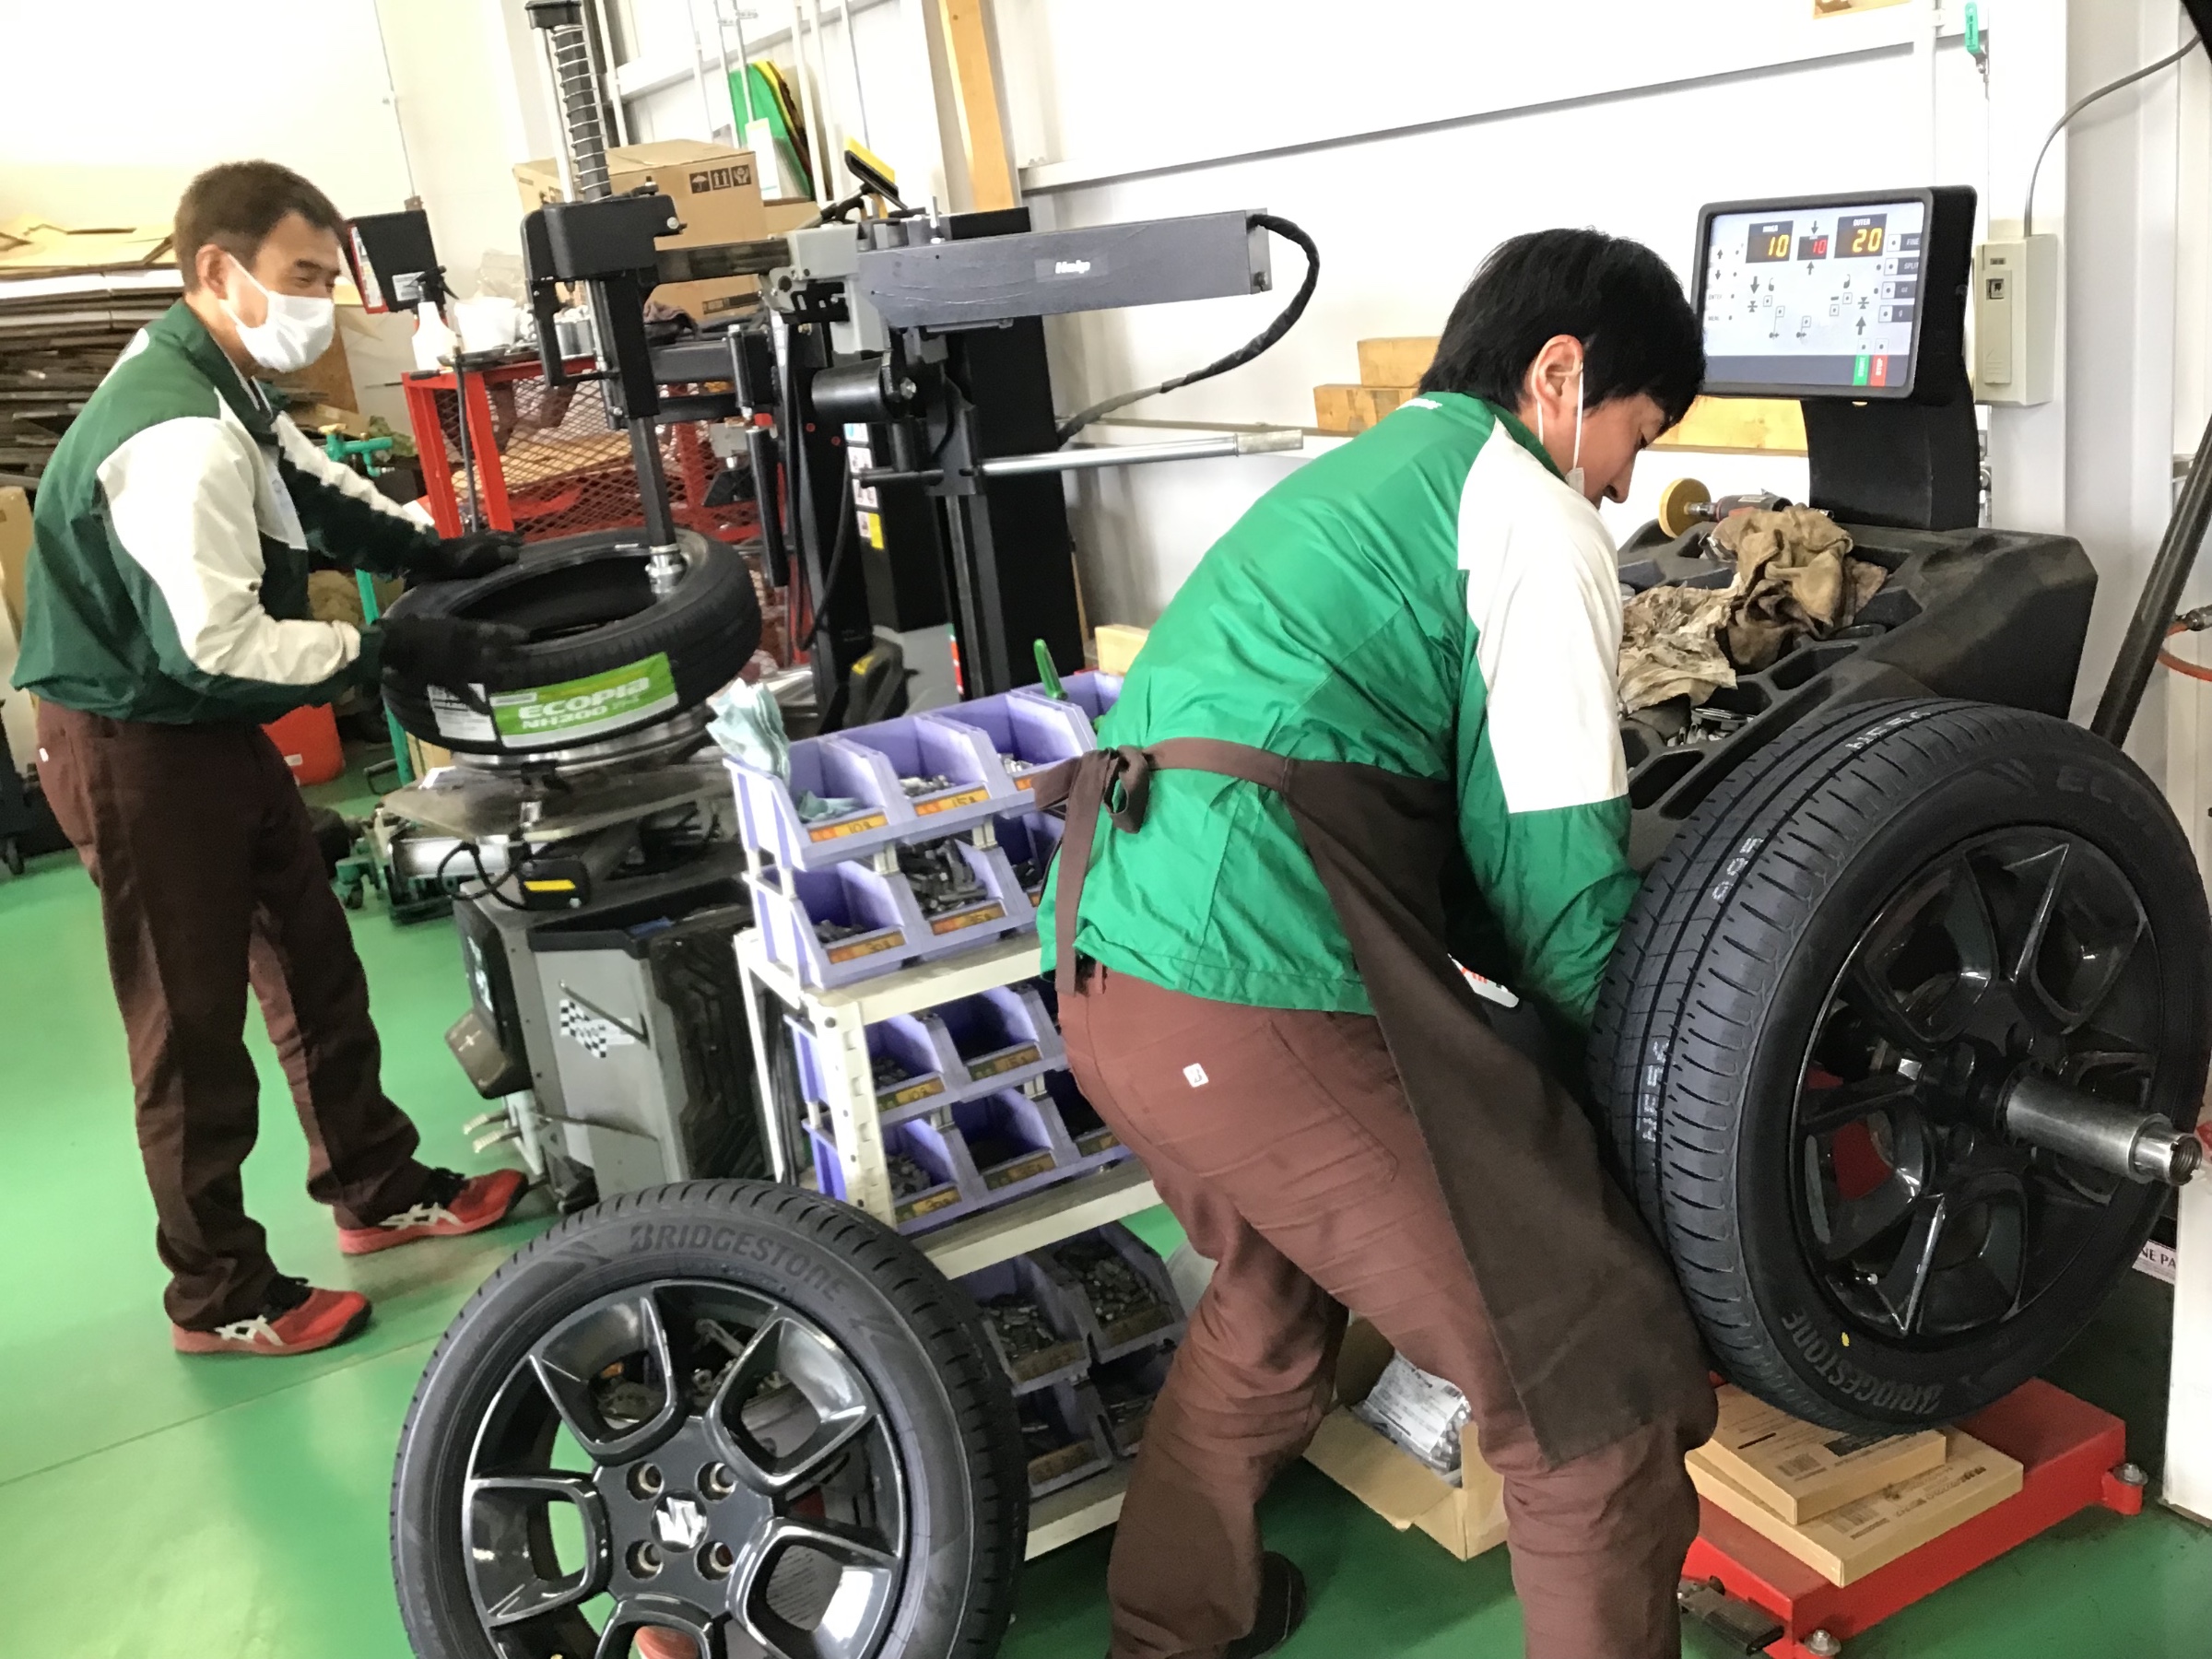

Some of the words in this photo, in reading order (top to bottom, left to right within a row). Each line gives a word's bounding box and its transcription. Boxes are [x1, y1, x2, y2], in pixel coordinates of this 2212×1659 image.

[1768, 234, 1790, 258] 10
[1813, 239, 1827, 254] 10
[1853, 228, 1883, 253] 20
[629, 1222, 847, 1301] BRIDGESTONE
[1781, 1309, 1946, 1416] BRIDGESTONE
